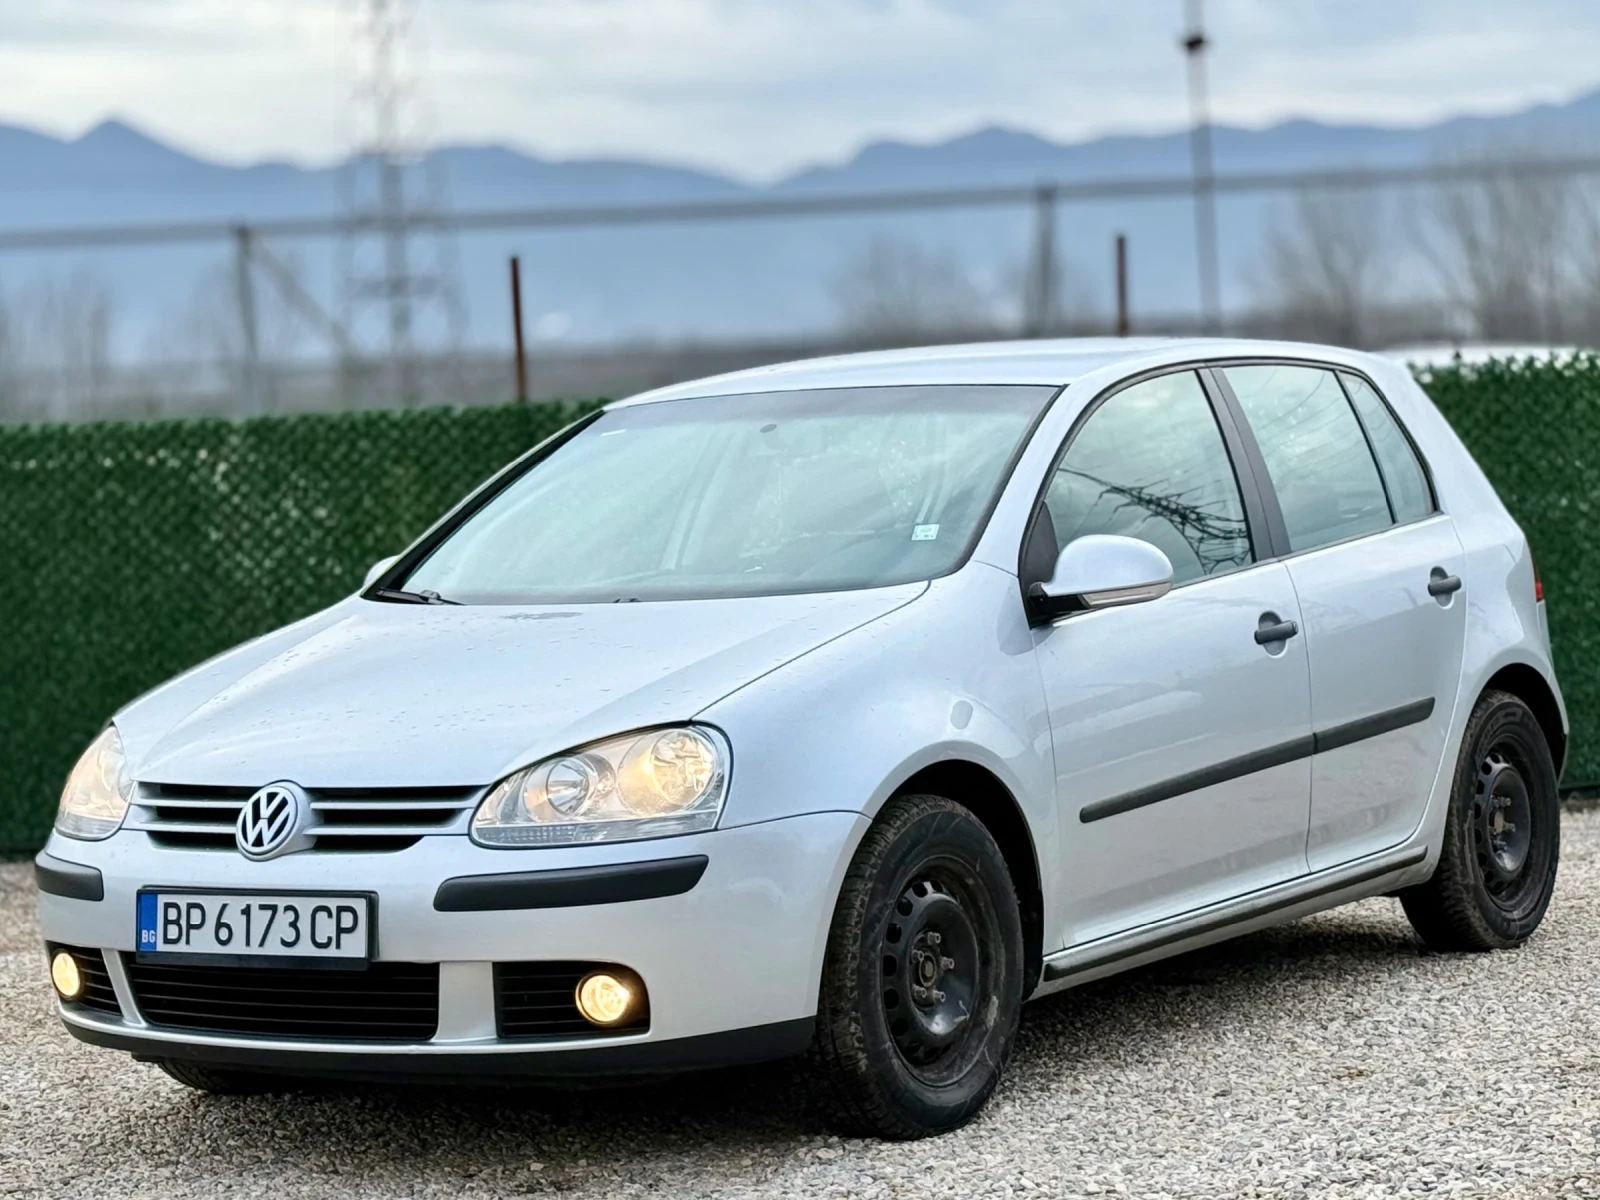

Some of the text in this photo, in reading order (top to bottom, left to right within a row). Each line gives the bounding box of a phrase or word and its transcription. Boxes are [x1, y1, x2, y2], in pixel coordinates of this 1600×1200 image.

[141, 929, 156, 944] BG
[163, 901, 359, 950] BP 6173 CP
